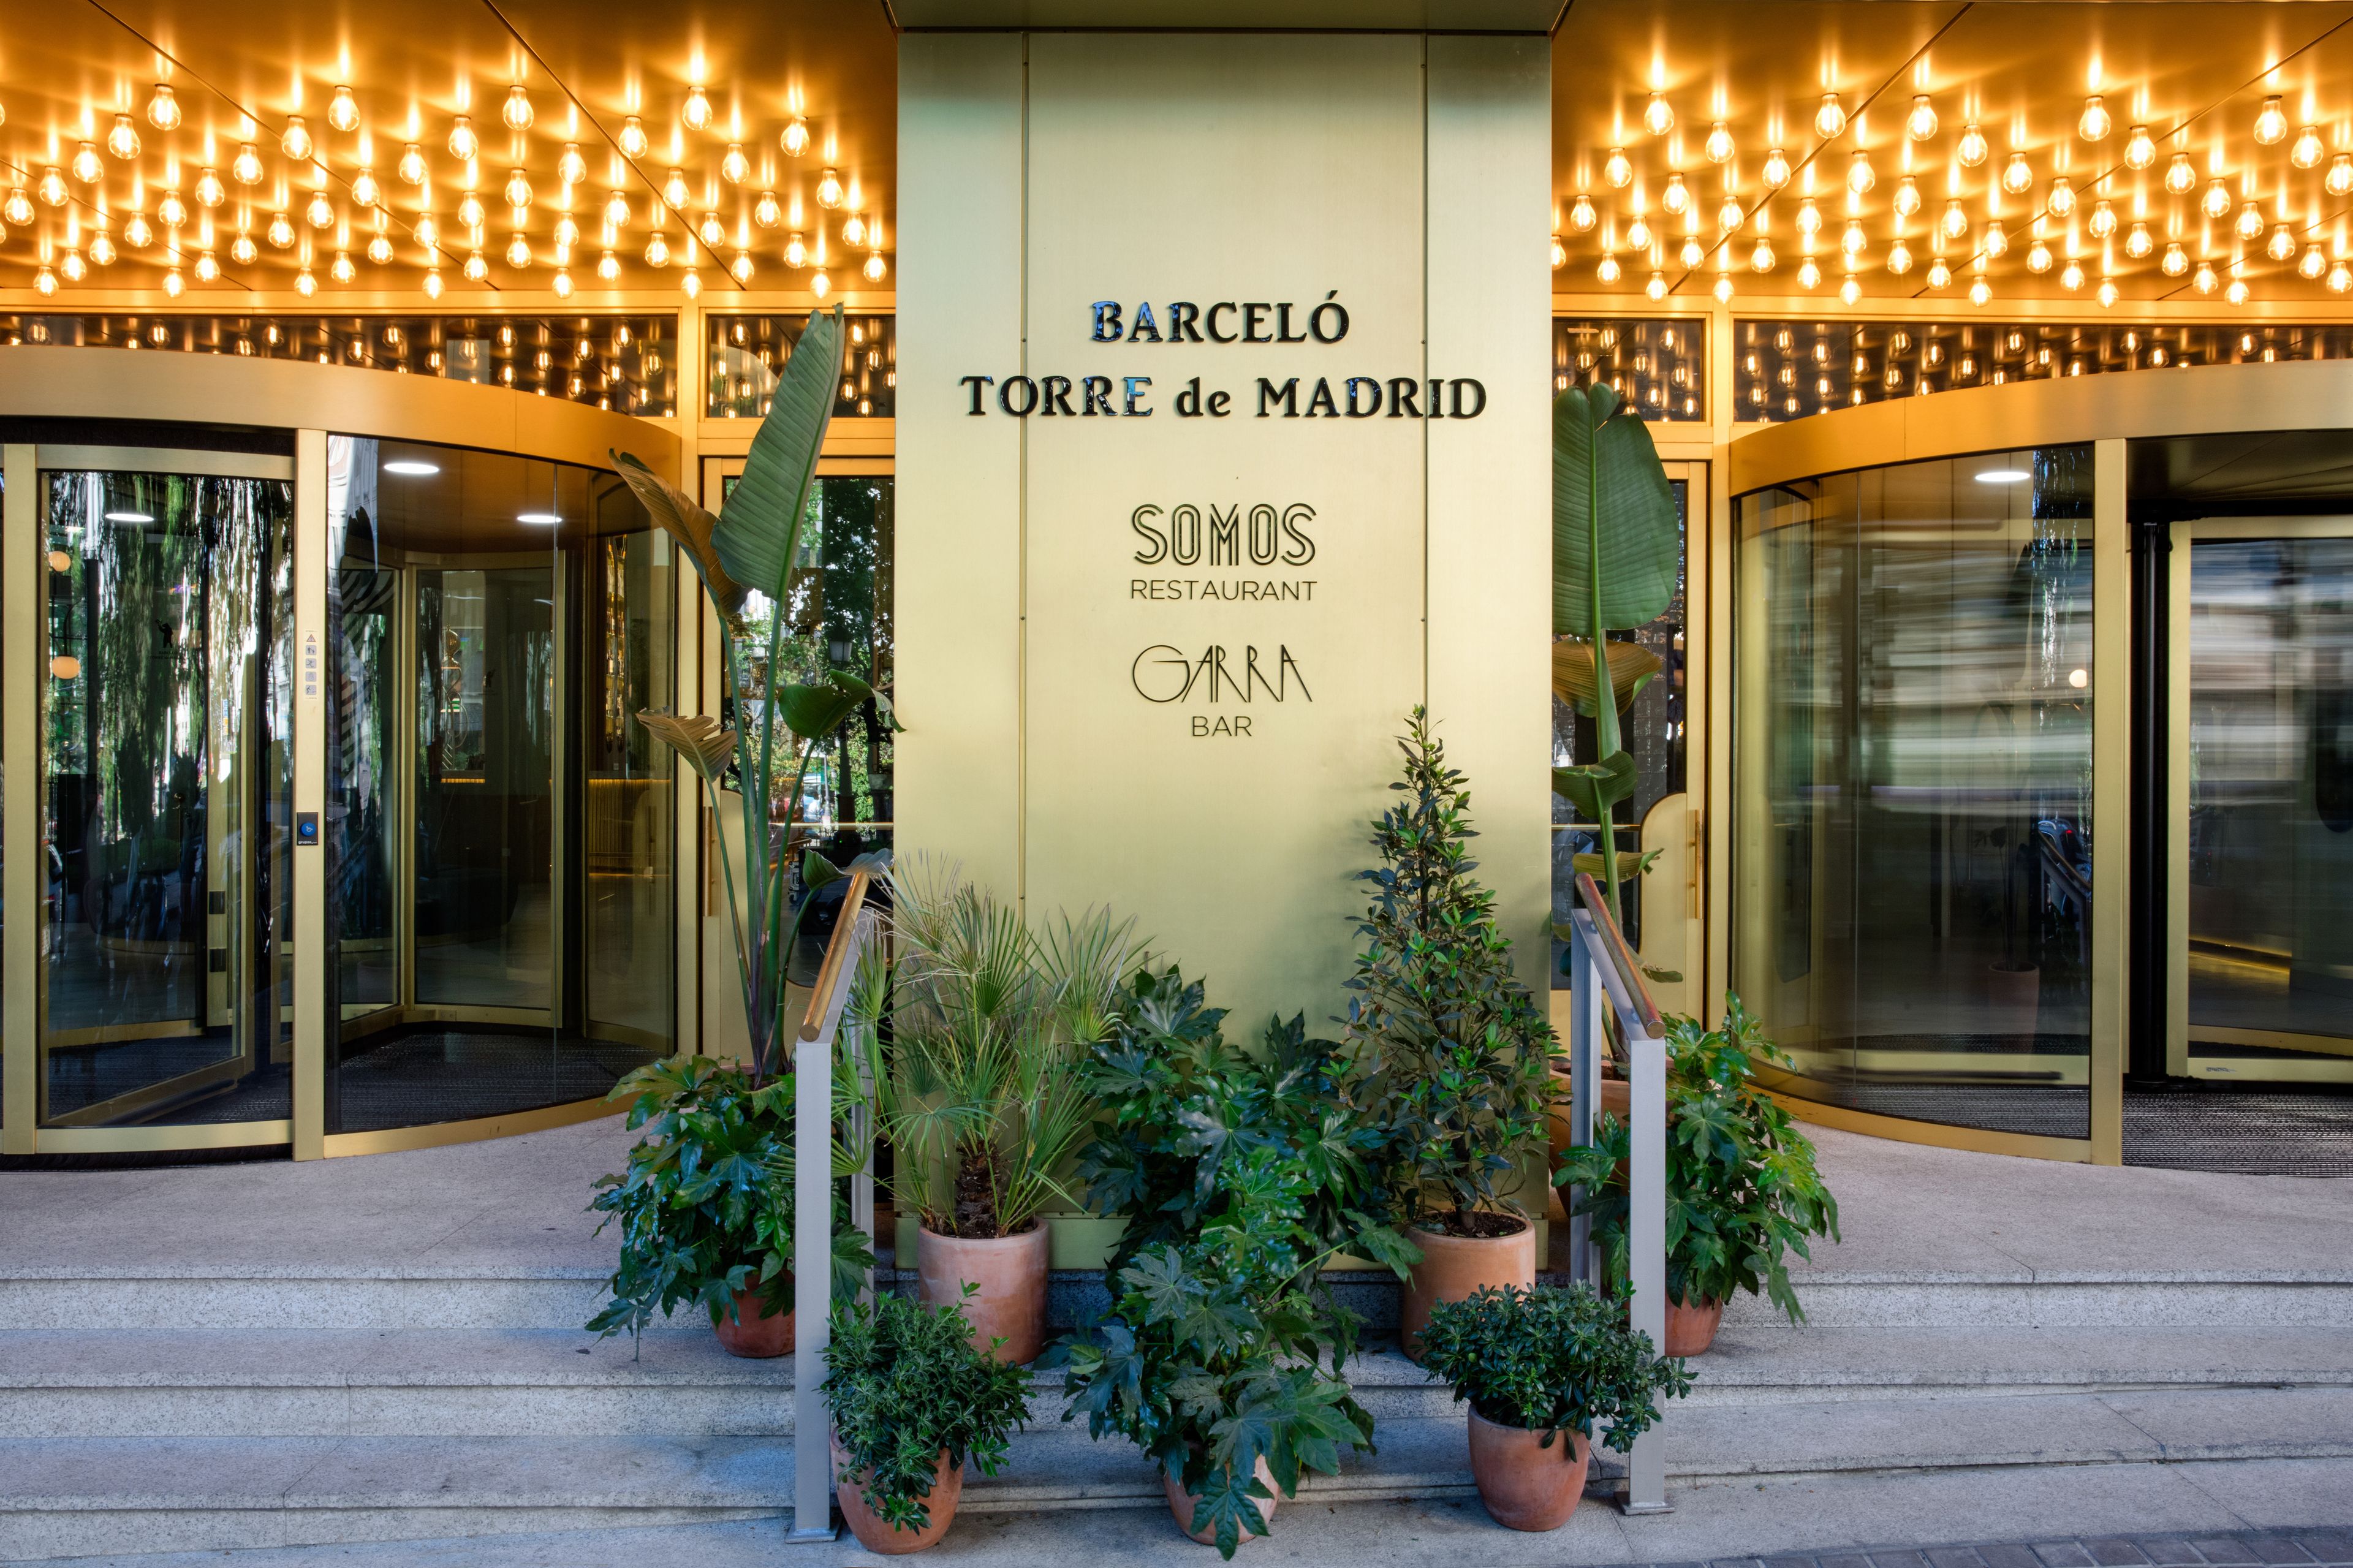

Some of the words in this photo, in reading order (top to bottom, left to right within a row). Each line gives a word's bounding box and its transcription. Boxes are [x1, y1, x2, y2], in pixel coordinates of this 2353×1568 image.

[1091, 290, 1349, 344] BARCELÓ
[960, 375, 1153, 417] TORRE
[1175, 376, 1231, 418] de
[1256, 376, 1487, 419] MADRID
[1131, 502, 1317, 567] SOMOS
[1131, 580, 1317, 601] RESTAURANT
[1131, 644, 1313, 703] GARRA
[1192, 716, 1252, 737] BAR
